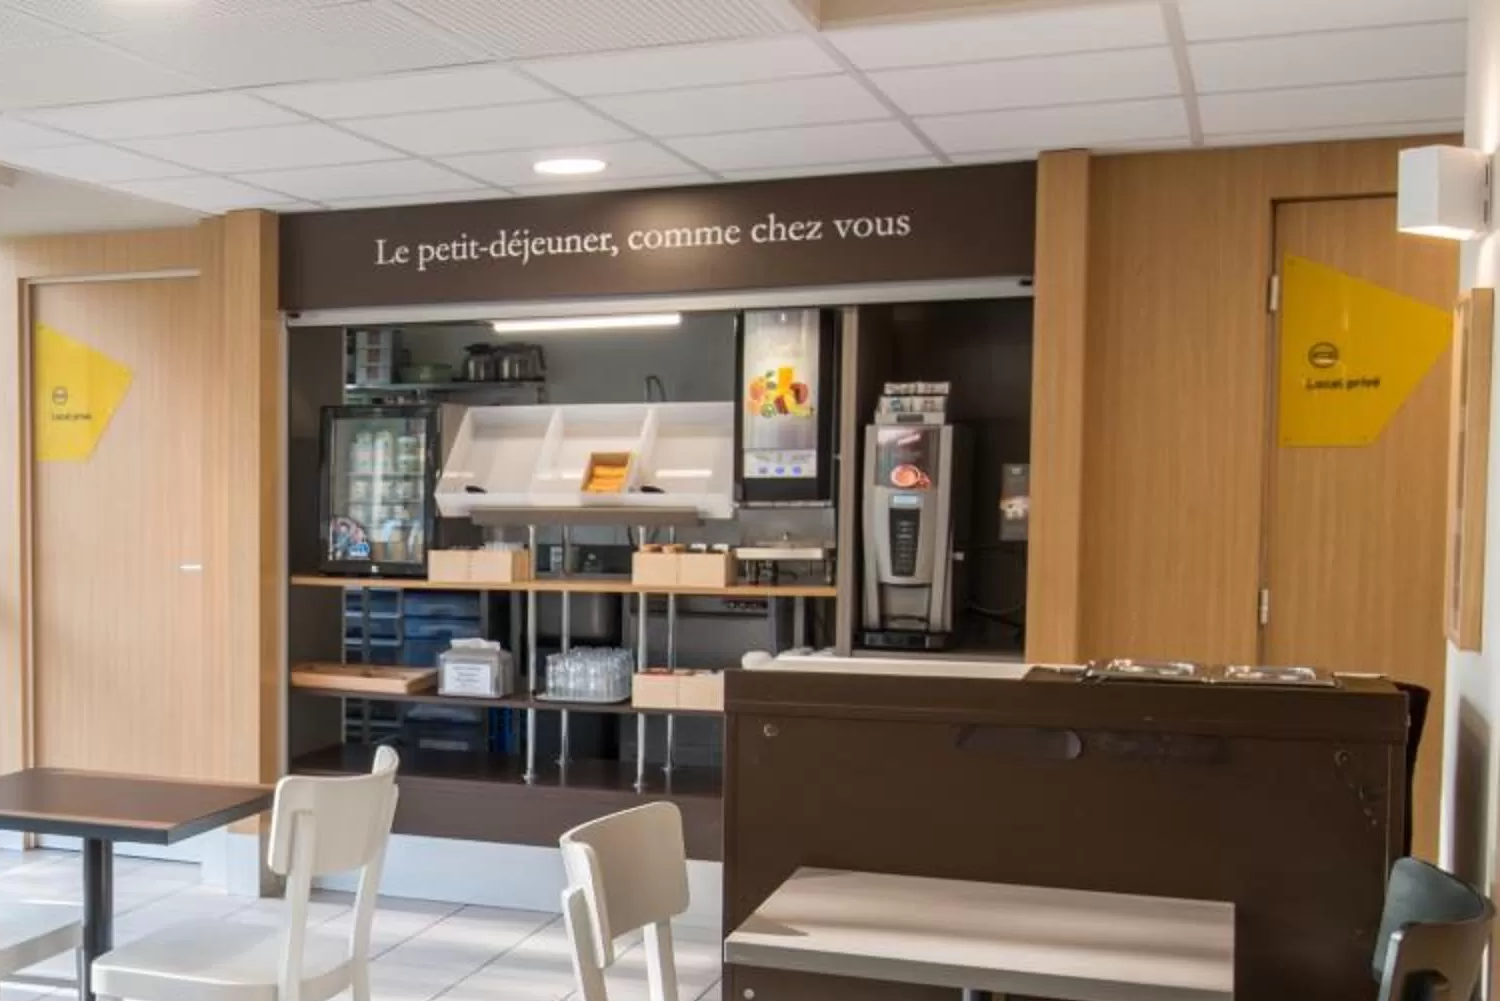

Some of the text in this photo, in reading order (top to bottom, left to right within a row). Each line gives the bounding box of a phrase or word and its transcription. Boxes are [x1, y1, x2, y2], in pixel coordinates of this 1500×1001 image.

[374, 213, 912, 272] Le petit-déjeuner, comme chez vous
